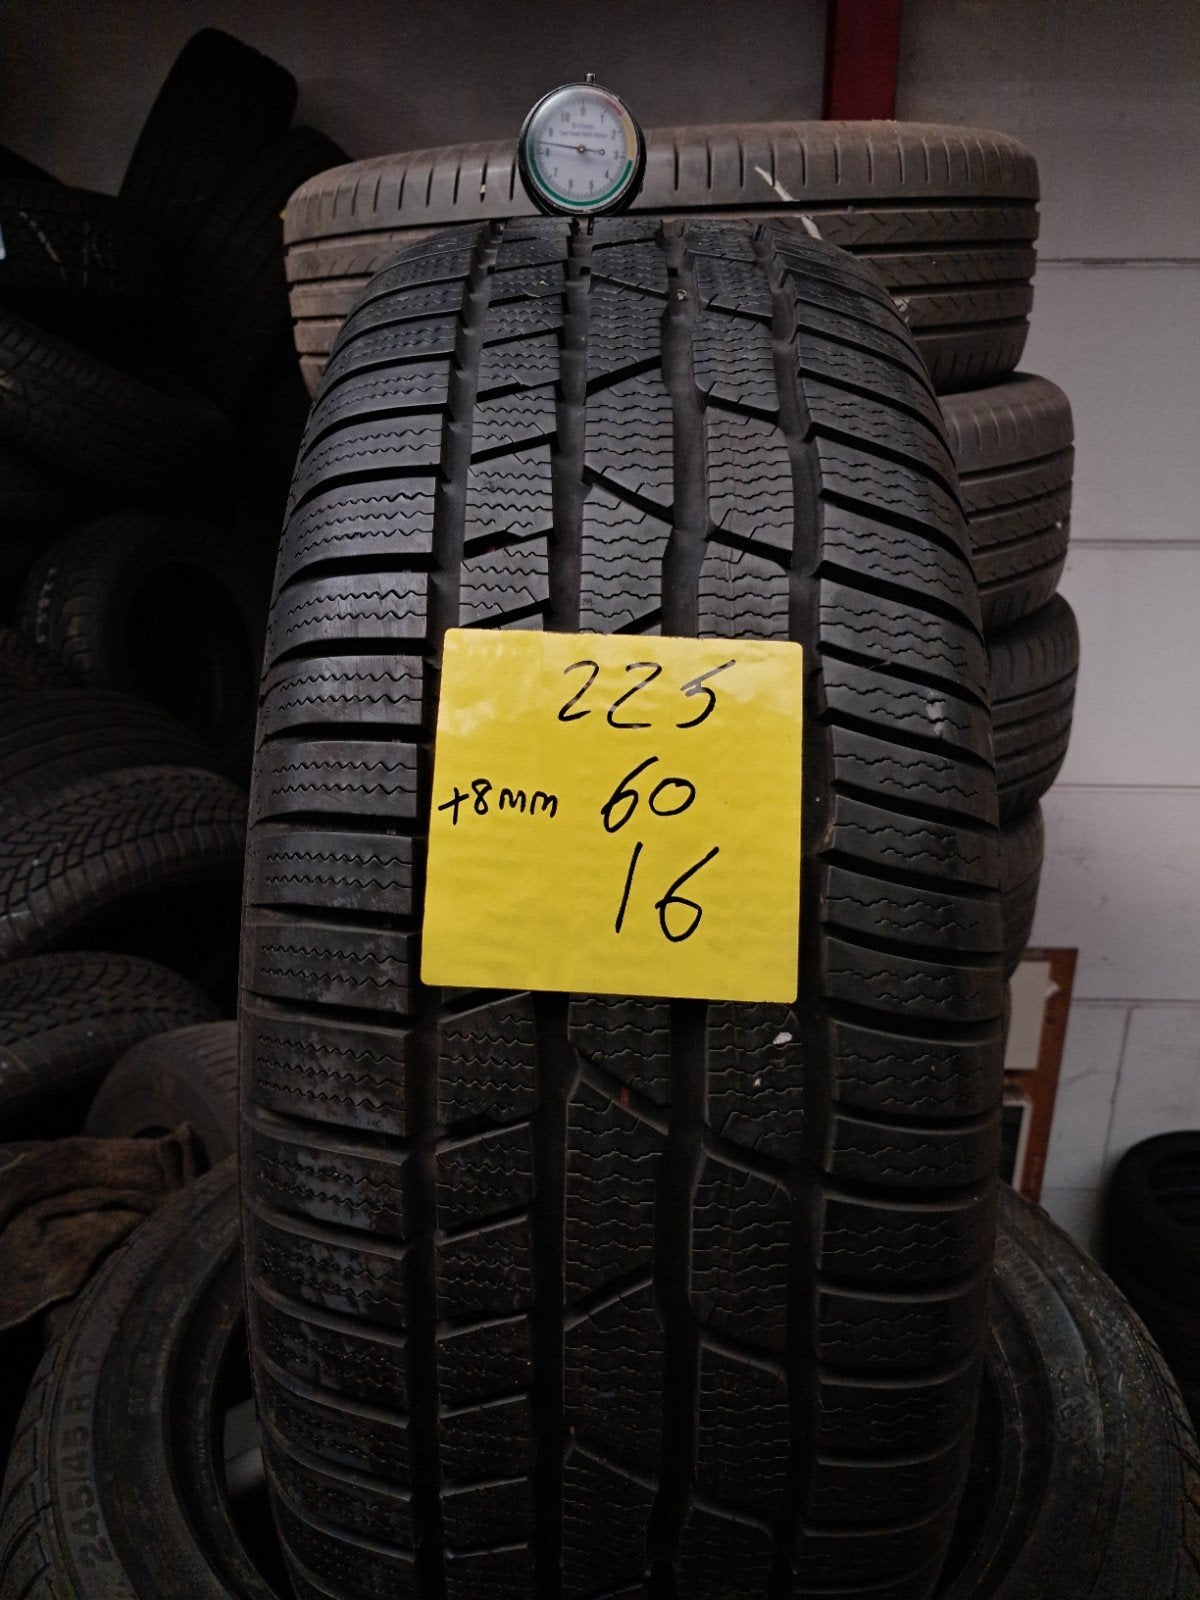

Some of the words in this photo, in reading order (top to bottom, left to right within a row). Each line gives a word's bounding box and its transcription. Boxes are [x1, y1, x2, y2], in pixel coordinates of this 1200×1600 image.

[557, 659, 737, 730] 225
[437, 778, 559, 825] +8mm
[600, 756, 696, 833] 60
[614, 841, 720, 943] 16
